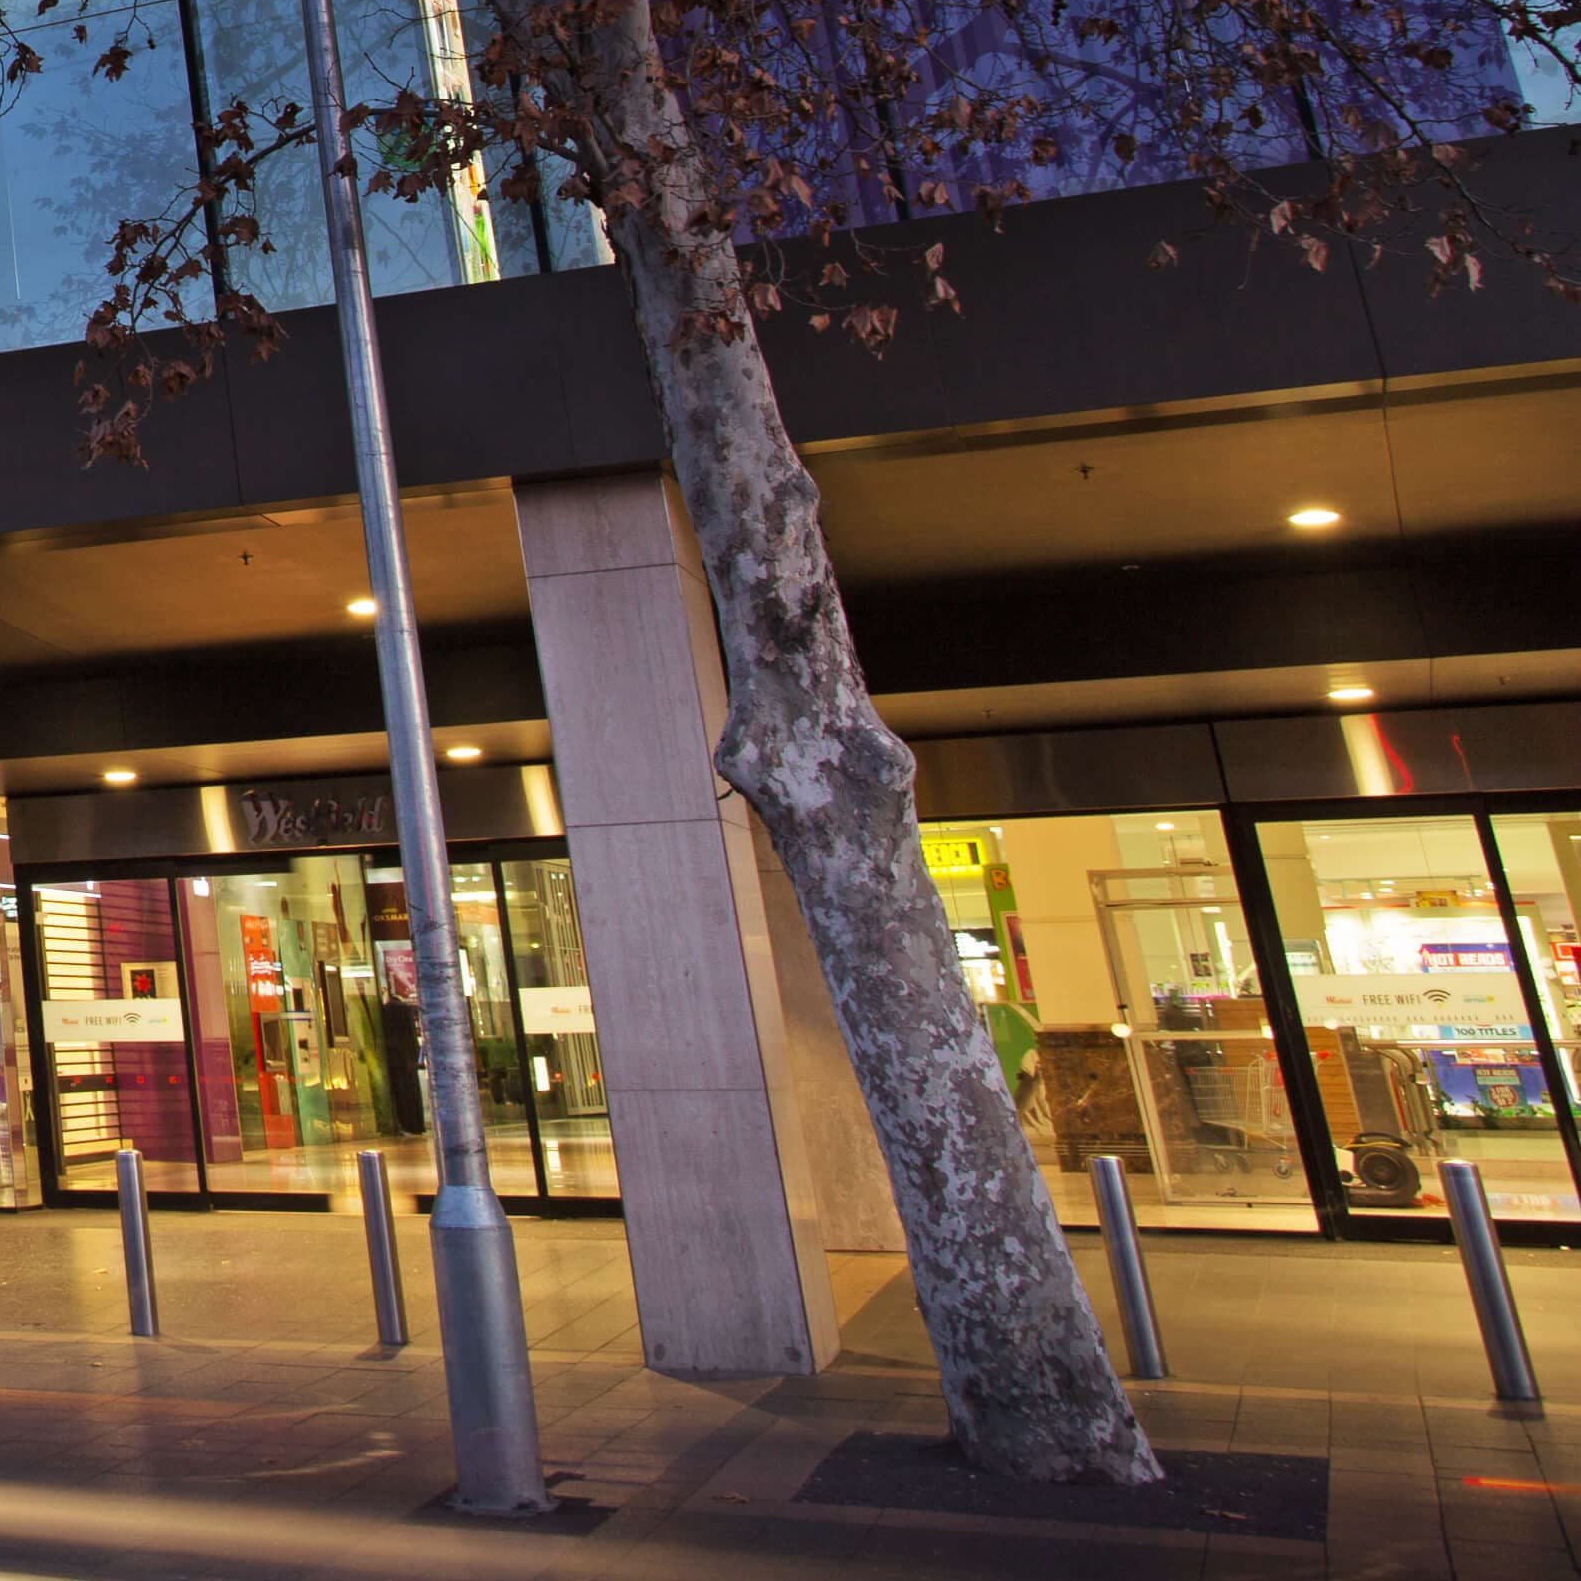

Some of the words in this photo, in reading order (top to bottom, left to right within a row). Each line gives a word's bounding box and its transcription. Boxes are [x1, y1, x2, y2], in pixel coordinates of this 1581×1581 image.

[1363, 994, 1391, 1005] FREE
[1395, 993, 1422, 1004] WIFI
[85, 1017, 103, 1026] FREE
[1478, 1027, 1517, 1036] TITLES
